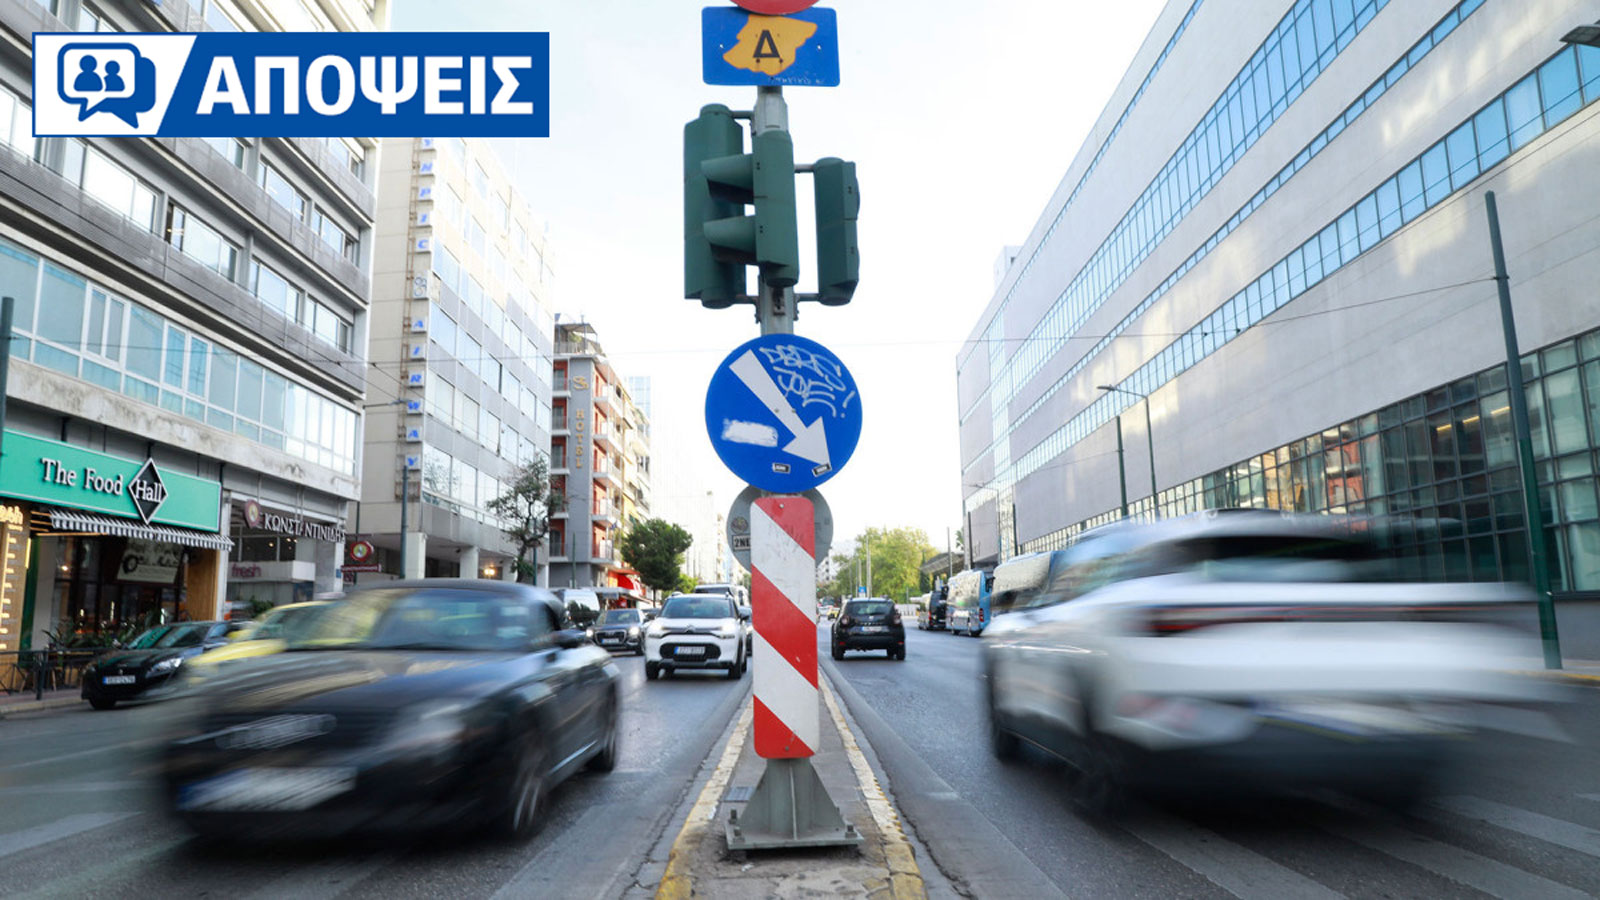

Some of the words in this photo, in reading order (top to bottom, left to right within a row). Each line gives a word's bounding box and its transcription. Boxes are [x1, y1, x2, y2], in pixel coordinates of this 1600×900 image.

[753, 29, 780, 58] Δ
[576, 408, 585, 469] HOTEL
[41, 457, 77, 486] The
[85, 467, 124, 495] Food
[136, 480, 162, 503] Hall
